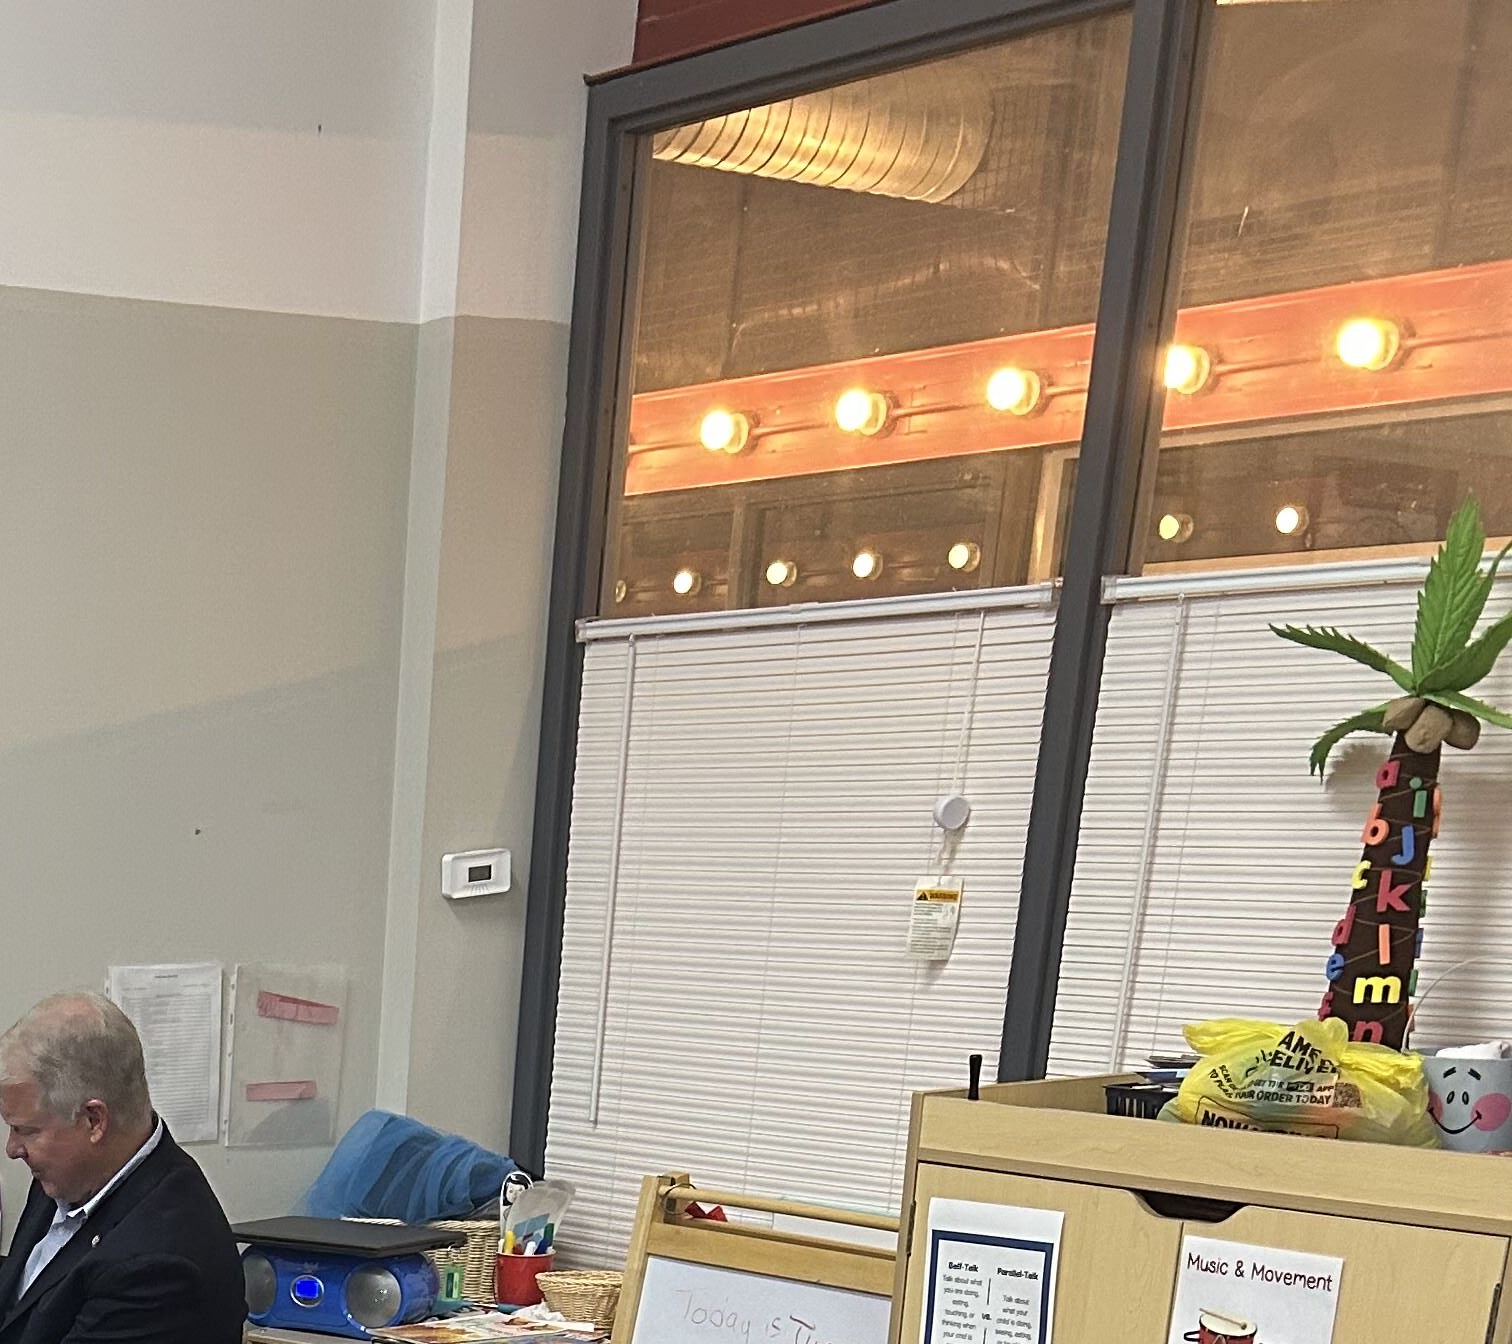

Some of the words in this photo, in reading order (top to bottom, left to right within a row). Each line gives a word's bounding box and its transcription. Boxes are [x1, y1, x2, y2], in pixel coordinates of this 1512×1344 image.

[1353, 976, 1401, 1004] m
[1256, 1092, 1293, 1103] ORDER
[1296, 1094, 1332, 1105] TODAY
[1187, 1253, 1229, 1276] Music
[1235, 1260, 1245, 1278] &
[1251, 1262, 1333, 1292] Movement
[765, 1316, 782, 1338] is
